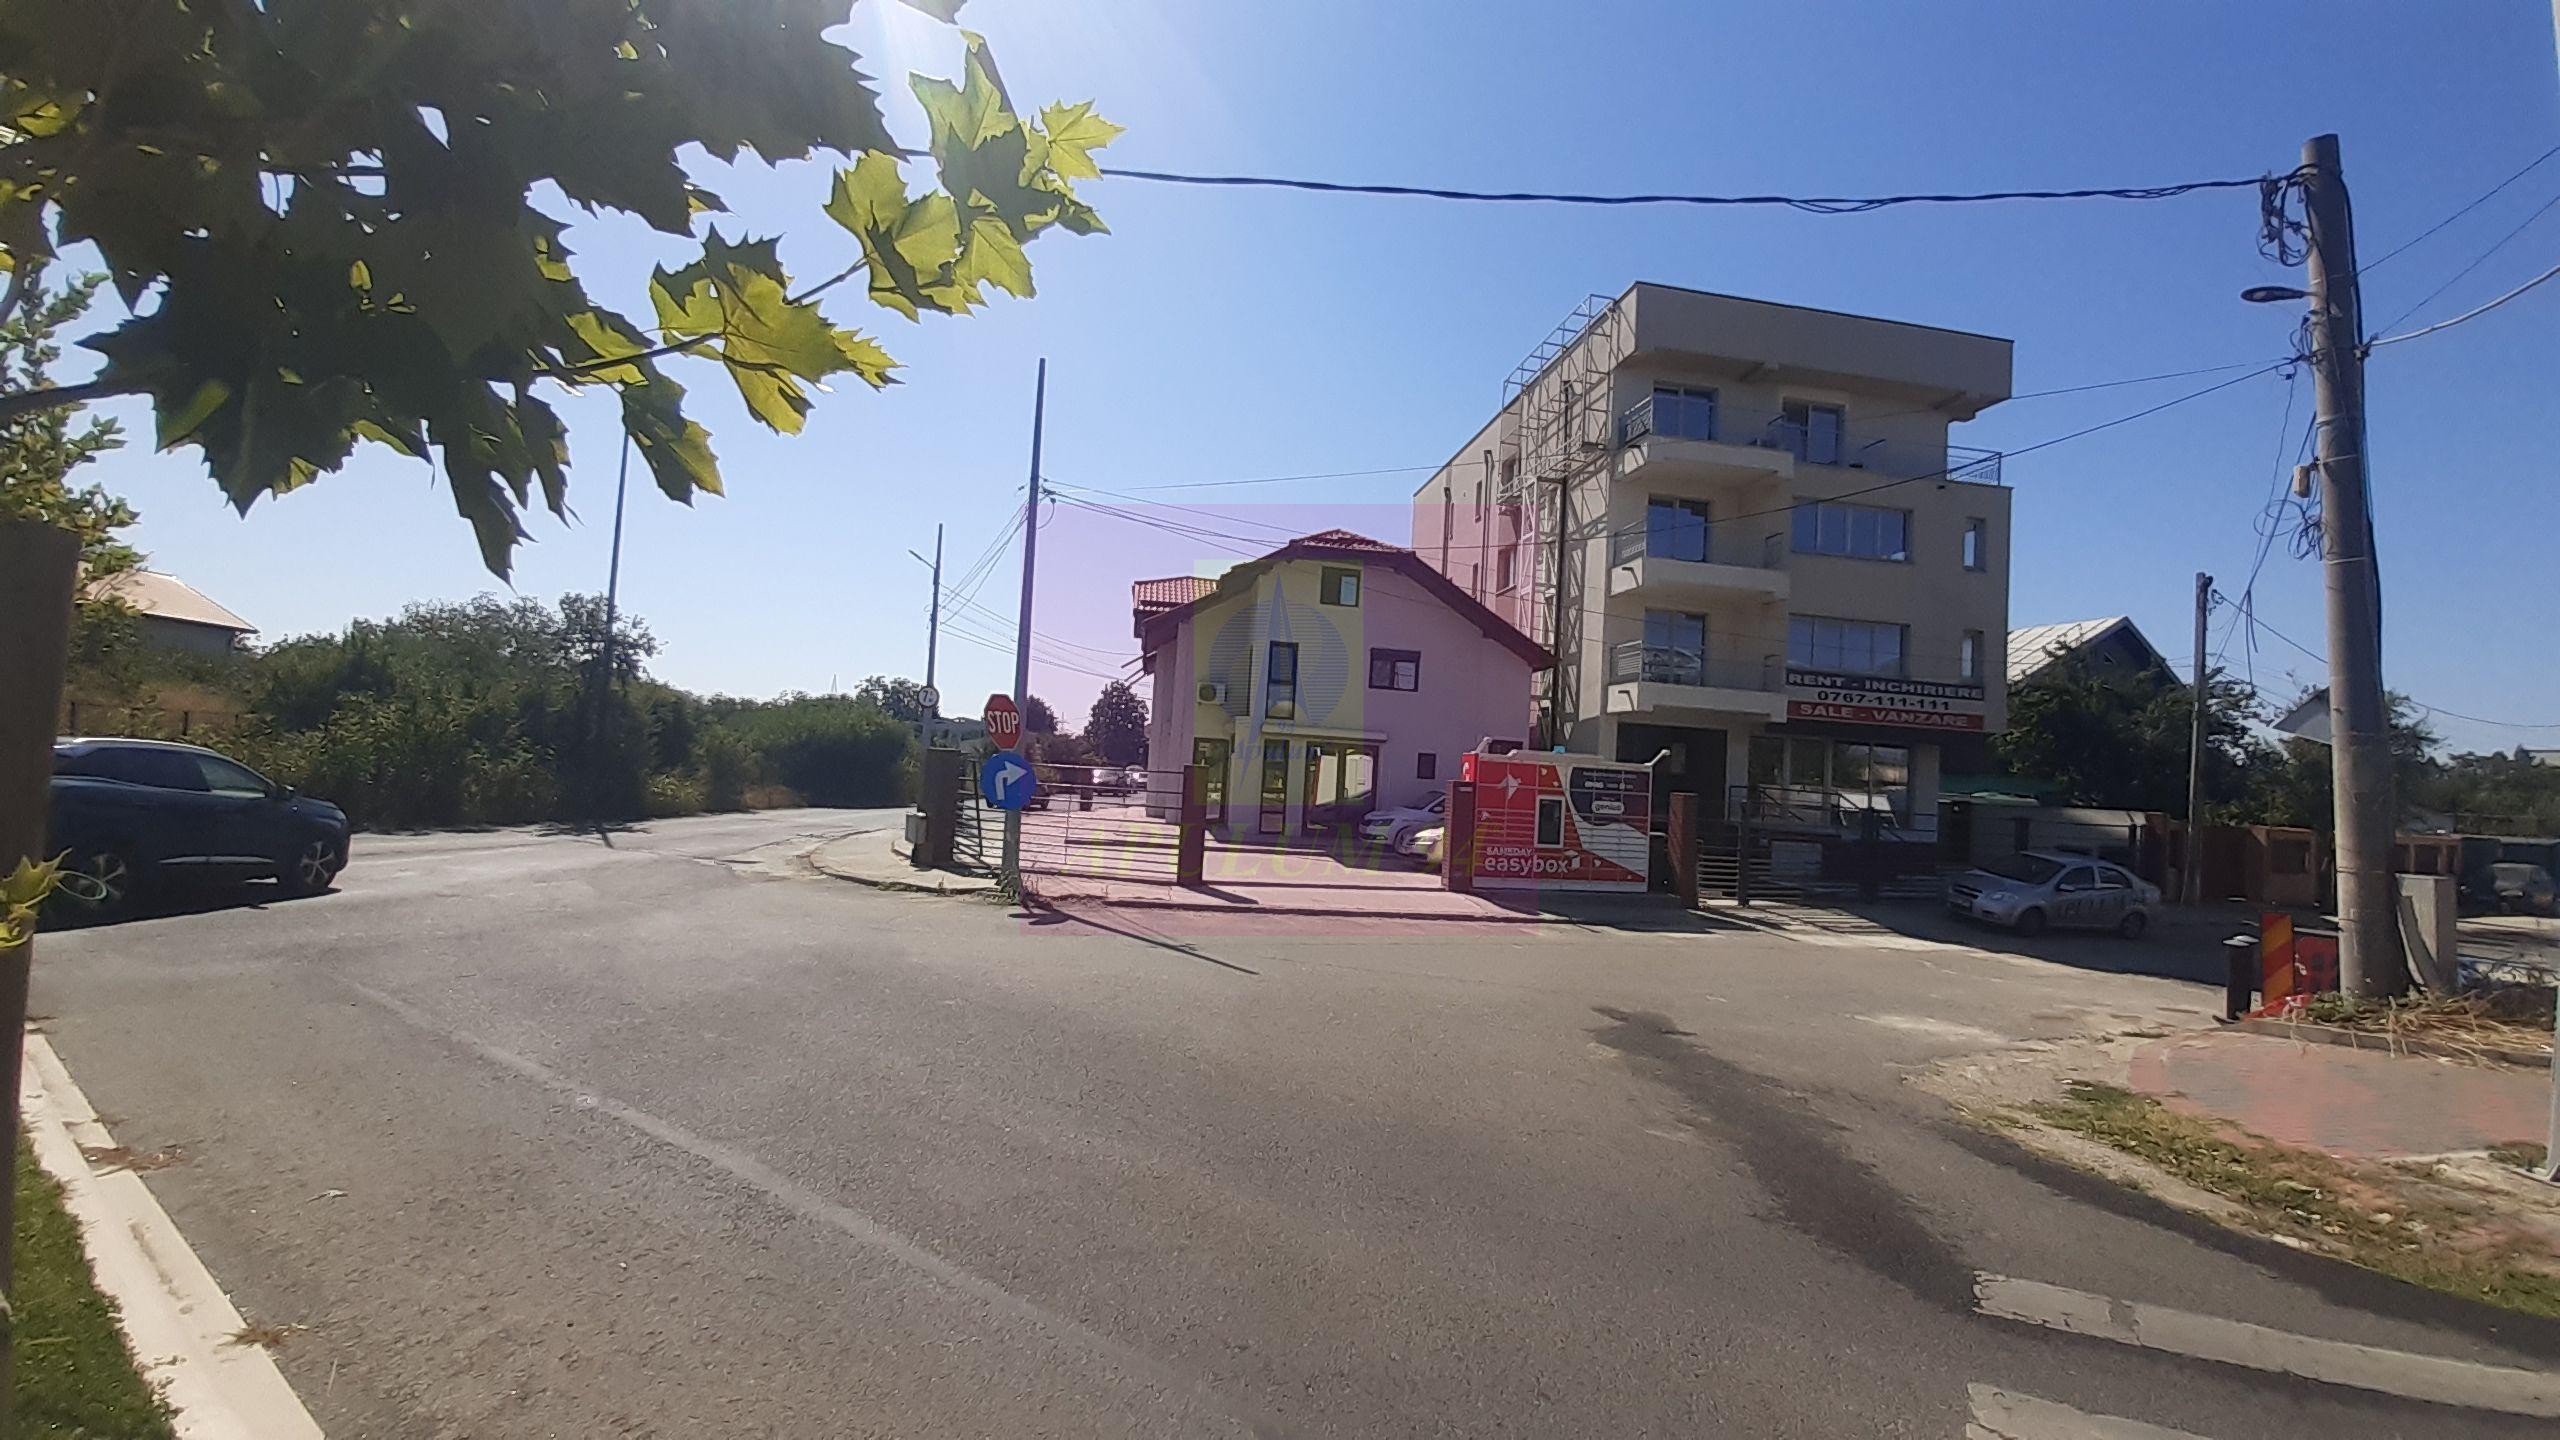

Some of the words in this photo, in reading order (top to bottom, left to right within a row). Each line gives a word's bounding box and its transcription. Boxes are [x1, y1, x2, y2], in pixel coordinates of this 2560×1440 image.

[1788, 673, 1845, 688] RENT
[1865, 679, 1985, 700] INCHIRIERE
[1817, 691, 1950, 711] 0767-111-111
[987, 711, 1020, 734] STOP
[1800, 703, 1853, 719] SALE
[1872, 709, 1968, 727] VANZARE
[1484, 855, 1569, 875] easybox
